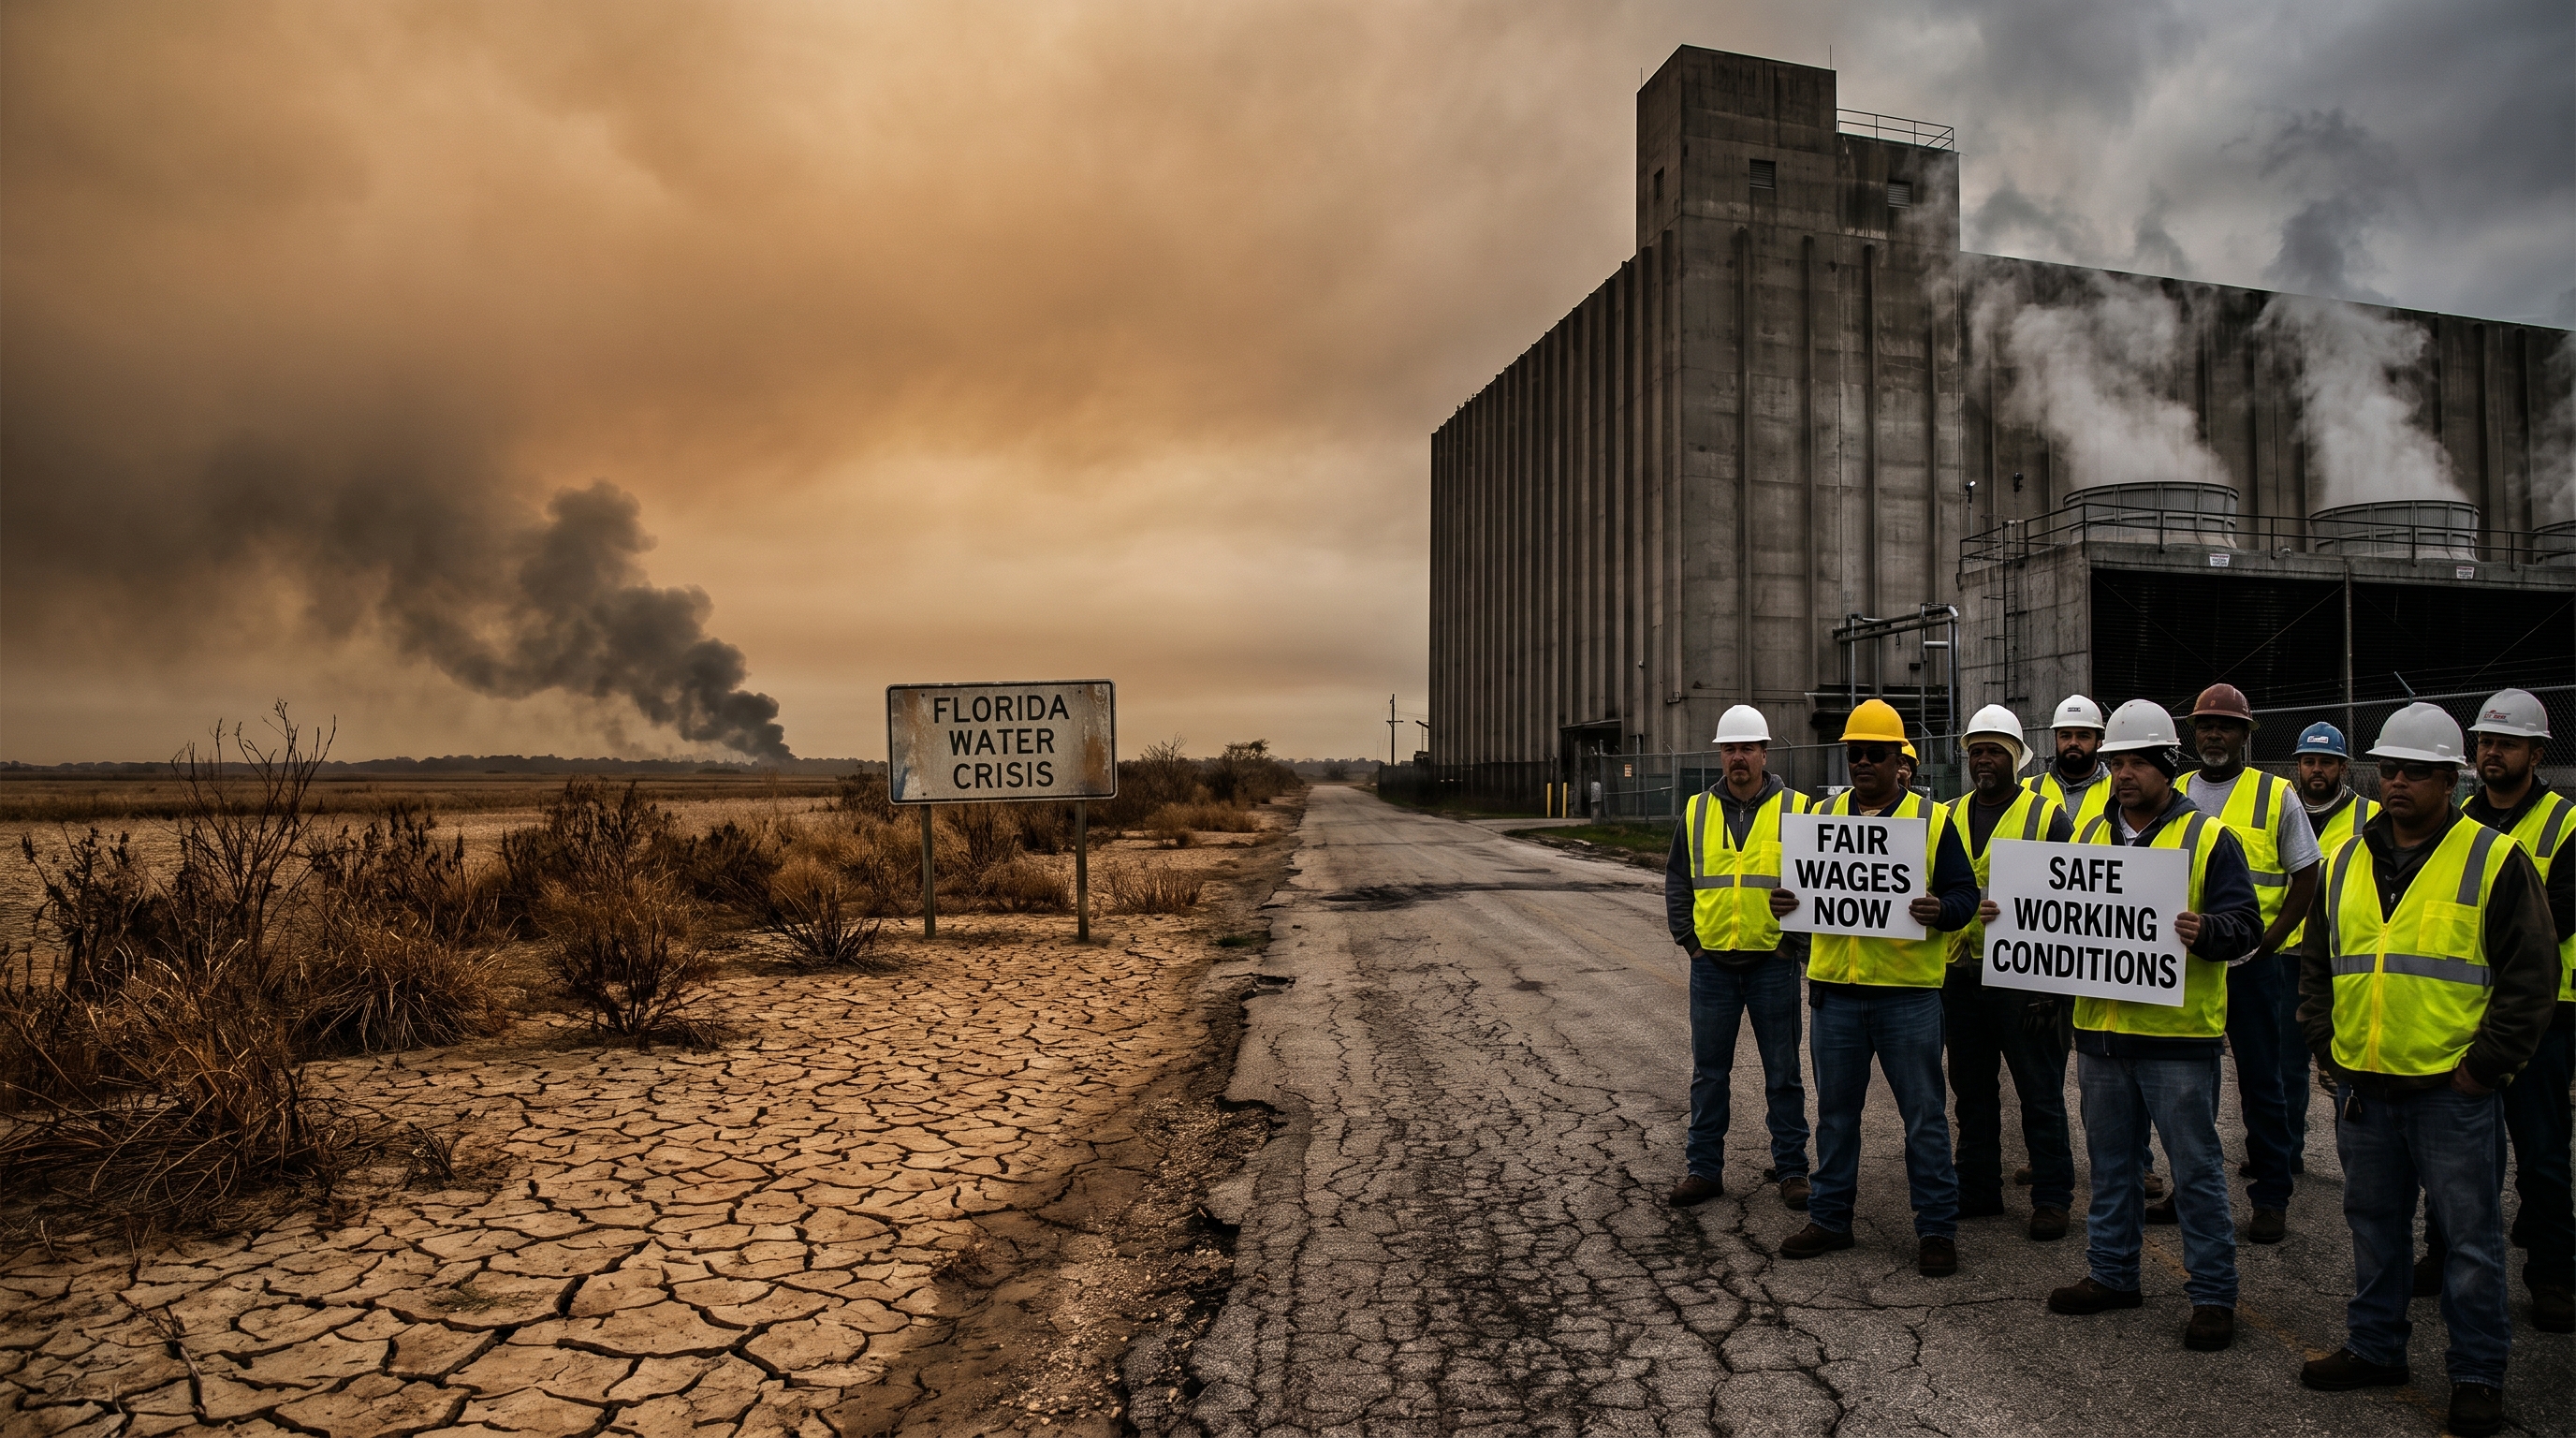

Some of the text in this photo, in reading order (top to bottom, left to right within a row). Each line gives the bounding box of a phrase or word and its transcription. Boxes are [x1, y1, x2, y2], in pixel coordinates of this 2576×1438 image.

[933, 694, 1070, 724] FLORIDA
[948, 727, 1055, 756] WATER
[953, 760, 1054, 790] CRISIS
[1817, 823, 1889, 856] FAIR
[1794, 858, 1911, 894] WAGES
[2048, 856, 2124, 895] SAFE
[1814, 895, 1893, 930] NOW
[2013, 897, 2158, 942] WORKING
[1992, 938, 2178, 990] CONDITIONS
